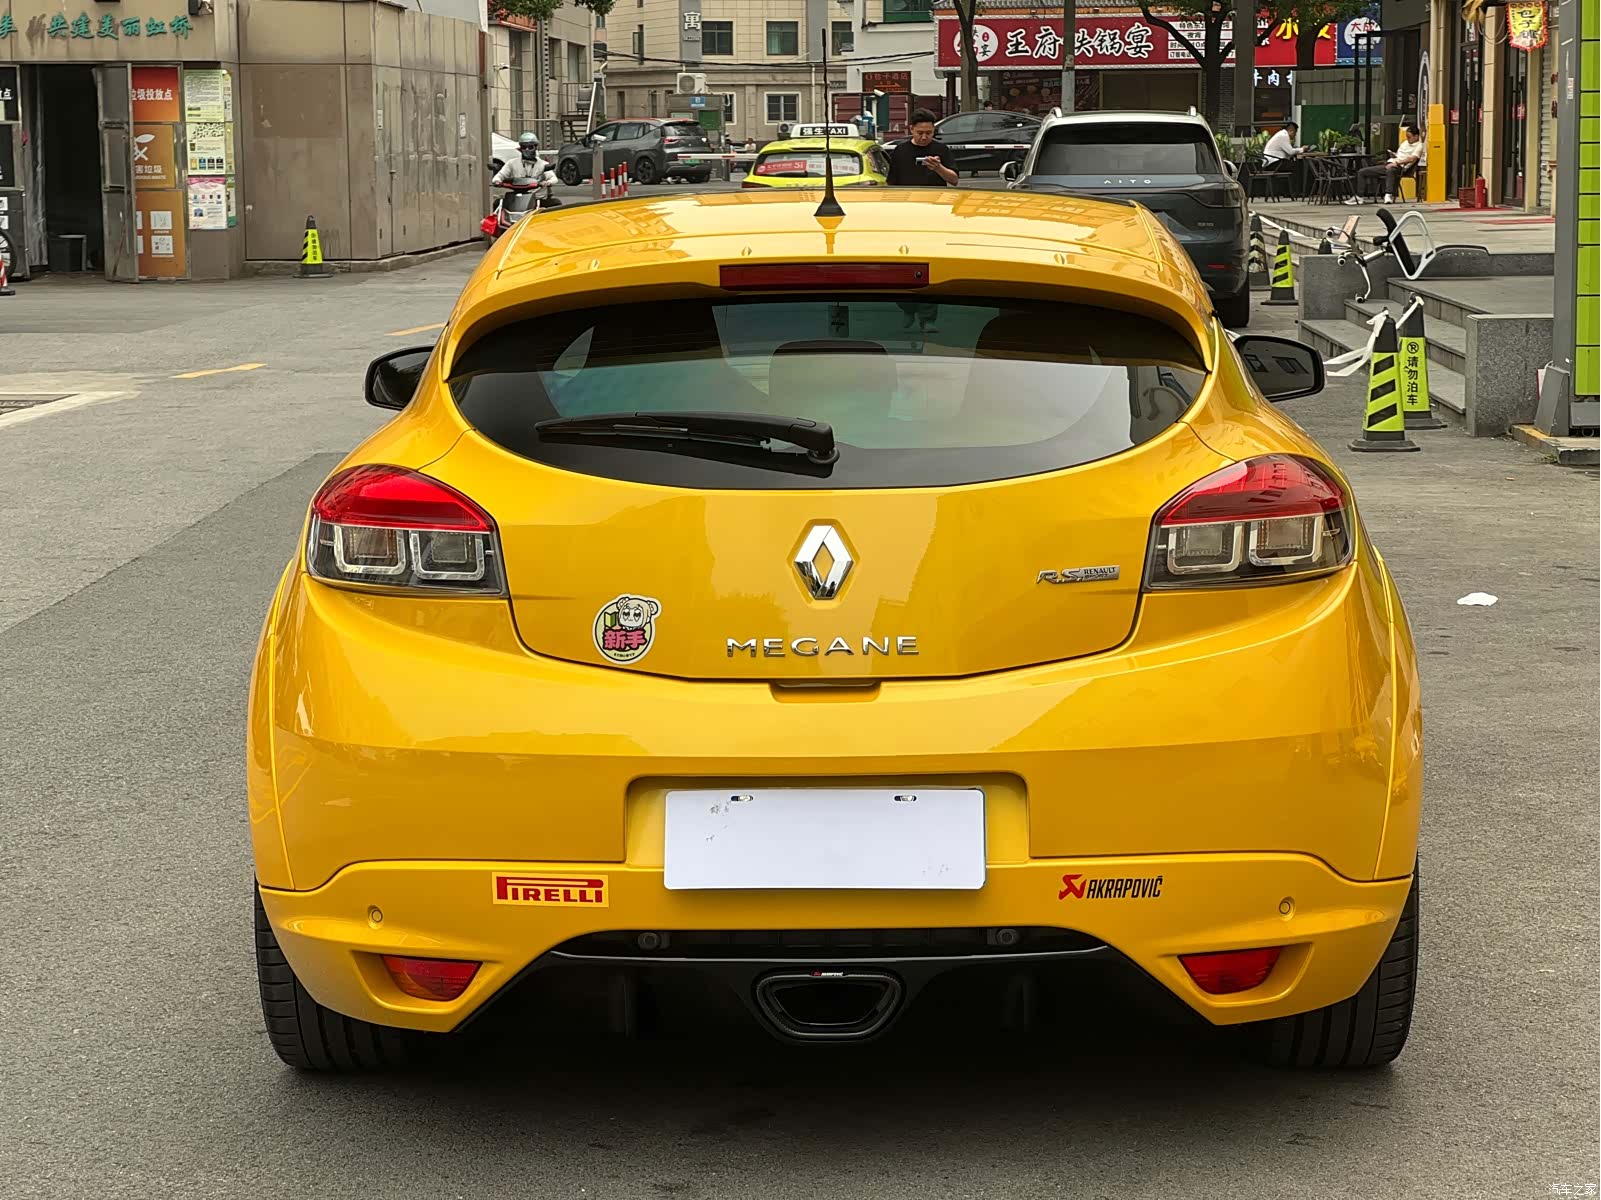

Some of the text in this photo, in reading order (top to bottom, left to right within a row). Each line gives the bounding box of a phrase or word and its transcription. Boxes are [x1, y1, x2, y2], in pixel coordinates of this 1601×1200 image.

[684, 12, 701, 30] 寓
[1407, 356, 1419, 405] 请勿泊车
[1084, 566, 1116, 575] RENAULT
[603, 629, 647, 651] 新手
[727, 636, 919, 658] MEGANE
[496, 876, 604, 903] PIRELLI
